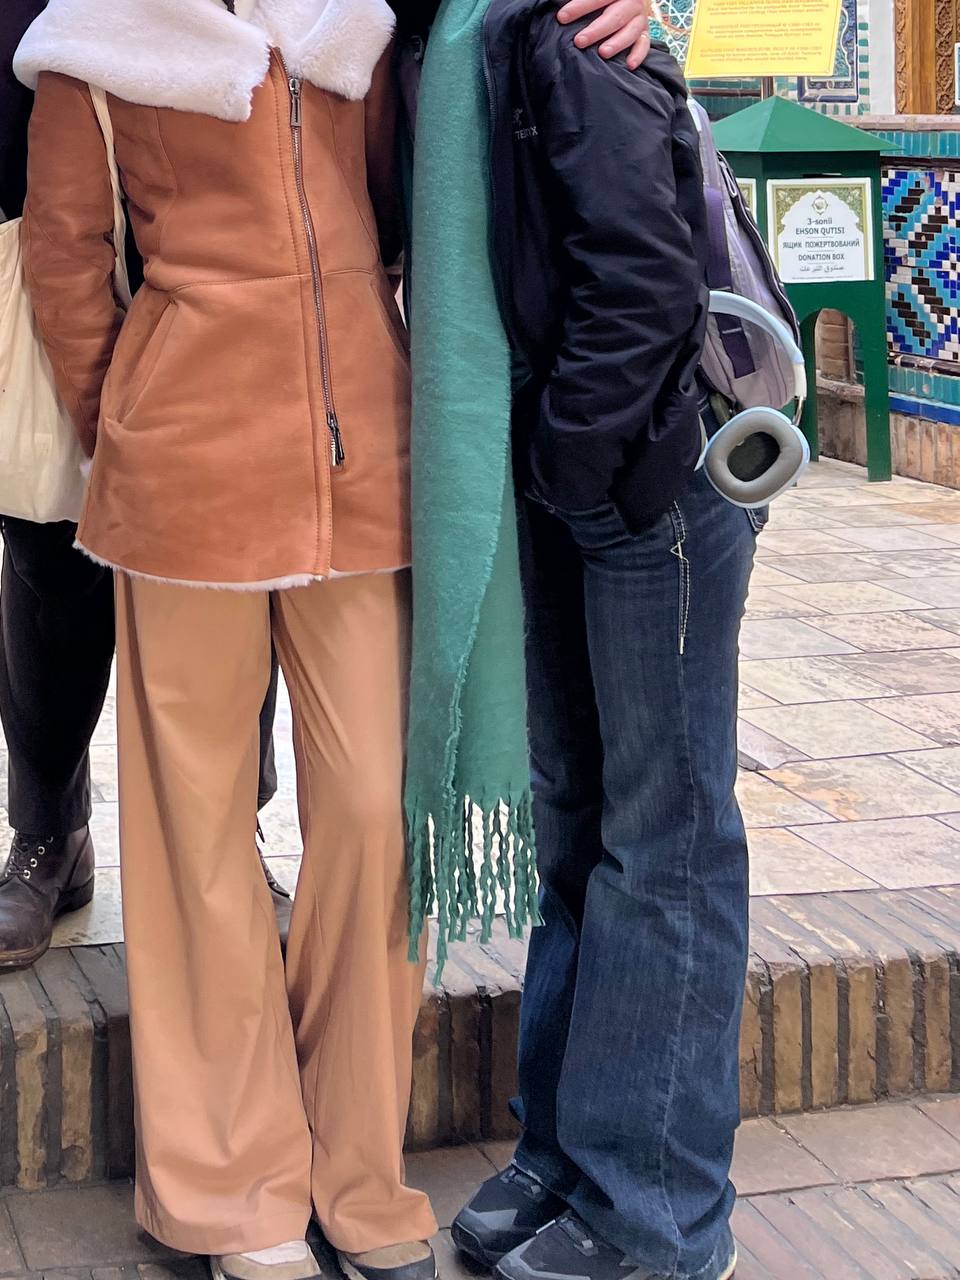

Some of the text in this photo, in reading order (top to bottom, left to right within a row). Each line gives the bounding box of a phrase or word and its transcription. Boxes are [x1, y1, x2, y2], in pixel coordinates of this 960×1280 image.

[795, 226, 845, 236] EHSON QUTISI
[782, 238, 860, 249] ЯЩИК ПОЖЕРТВОВАНИЙ
